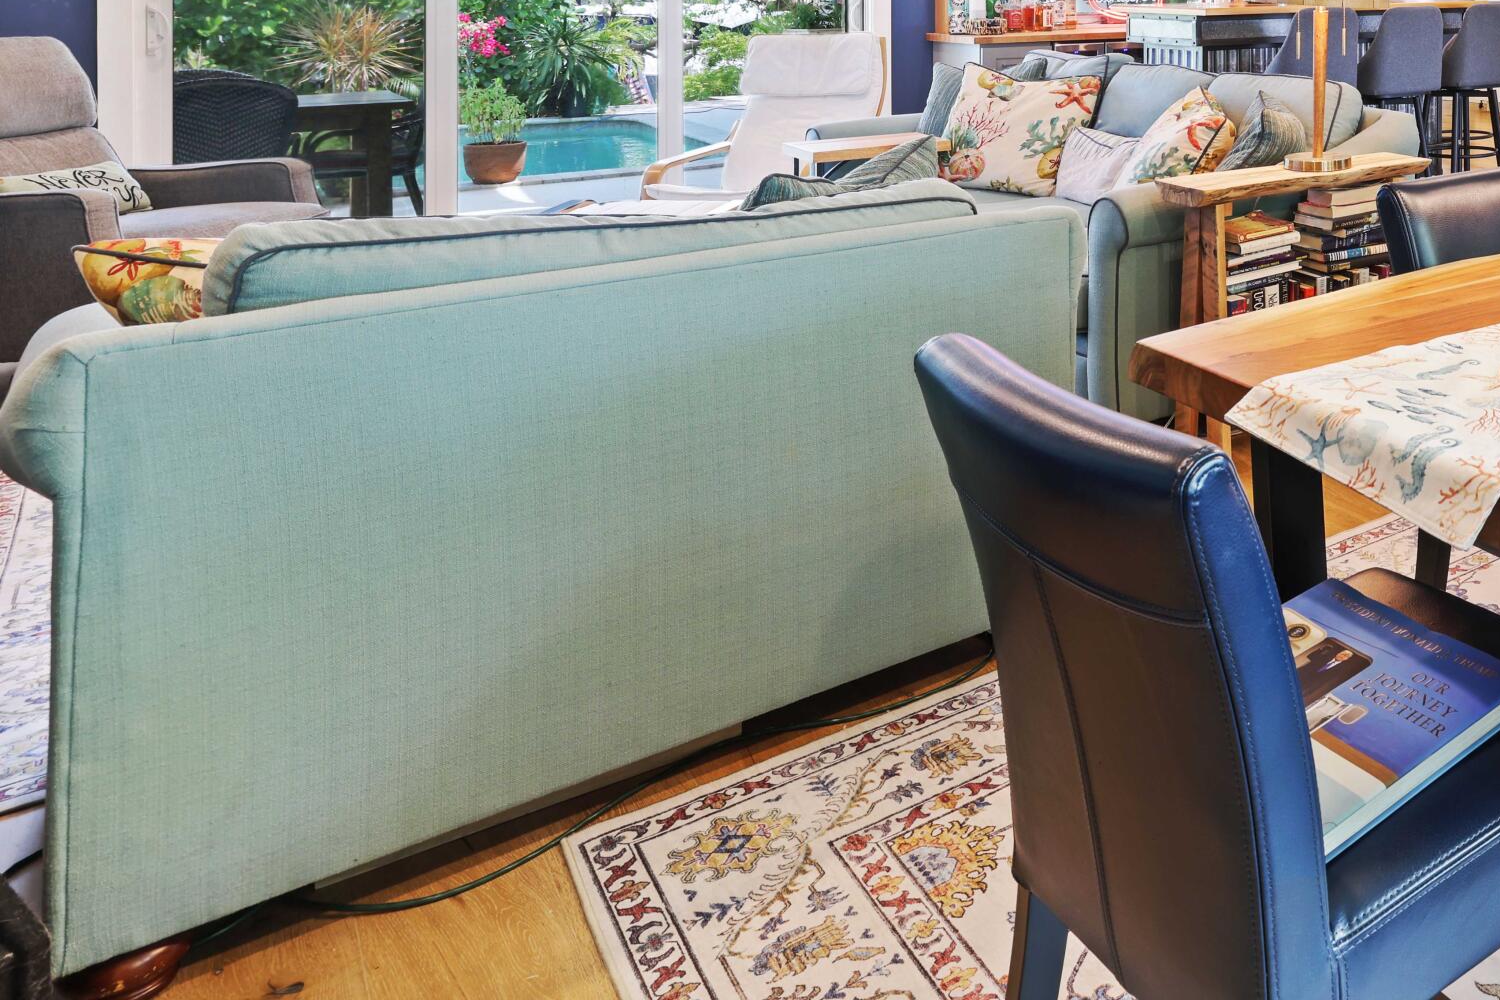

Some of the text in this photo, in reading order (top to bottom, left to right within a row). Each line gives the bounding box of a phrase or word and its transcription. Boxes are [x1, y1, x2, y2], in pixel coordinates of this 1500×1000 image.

[1369, 672, 1459, 718] JOURNEY
[1410, 671, 1450, 695] OUR
[1350, 679, 1447, 738] TOGETHER
